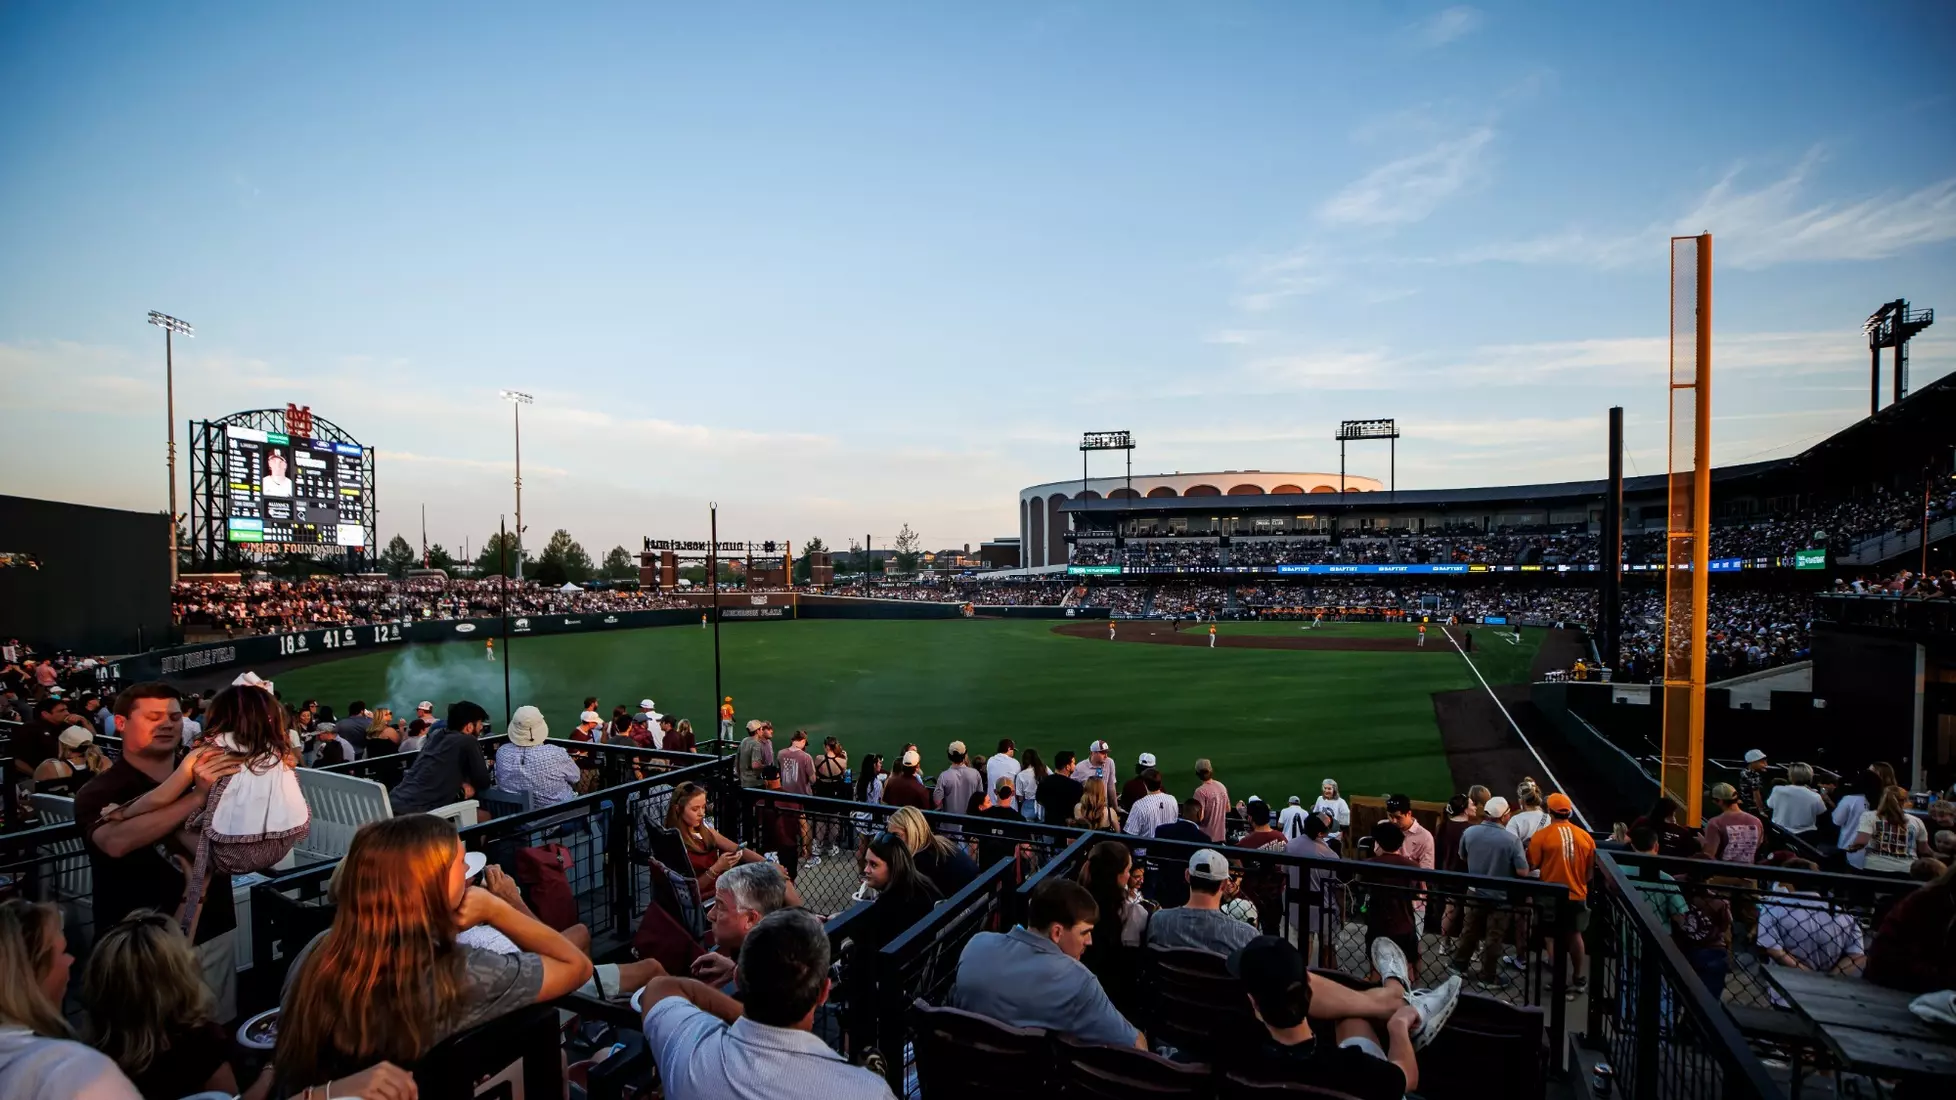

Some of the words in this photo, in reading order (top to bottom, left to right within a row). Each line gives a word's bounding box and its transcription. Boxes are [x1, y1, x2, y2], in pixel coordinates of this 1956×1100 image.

[251, 542, 279, 553] MIZE
[284, 543, 347, 555] FOUNDATION
[323, 630, 339, 648] 41
[374, 626, 388, 643] 12
[280, 635, 295, 655] 18
[211, 646, 236, 663] FIELD
